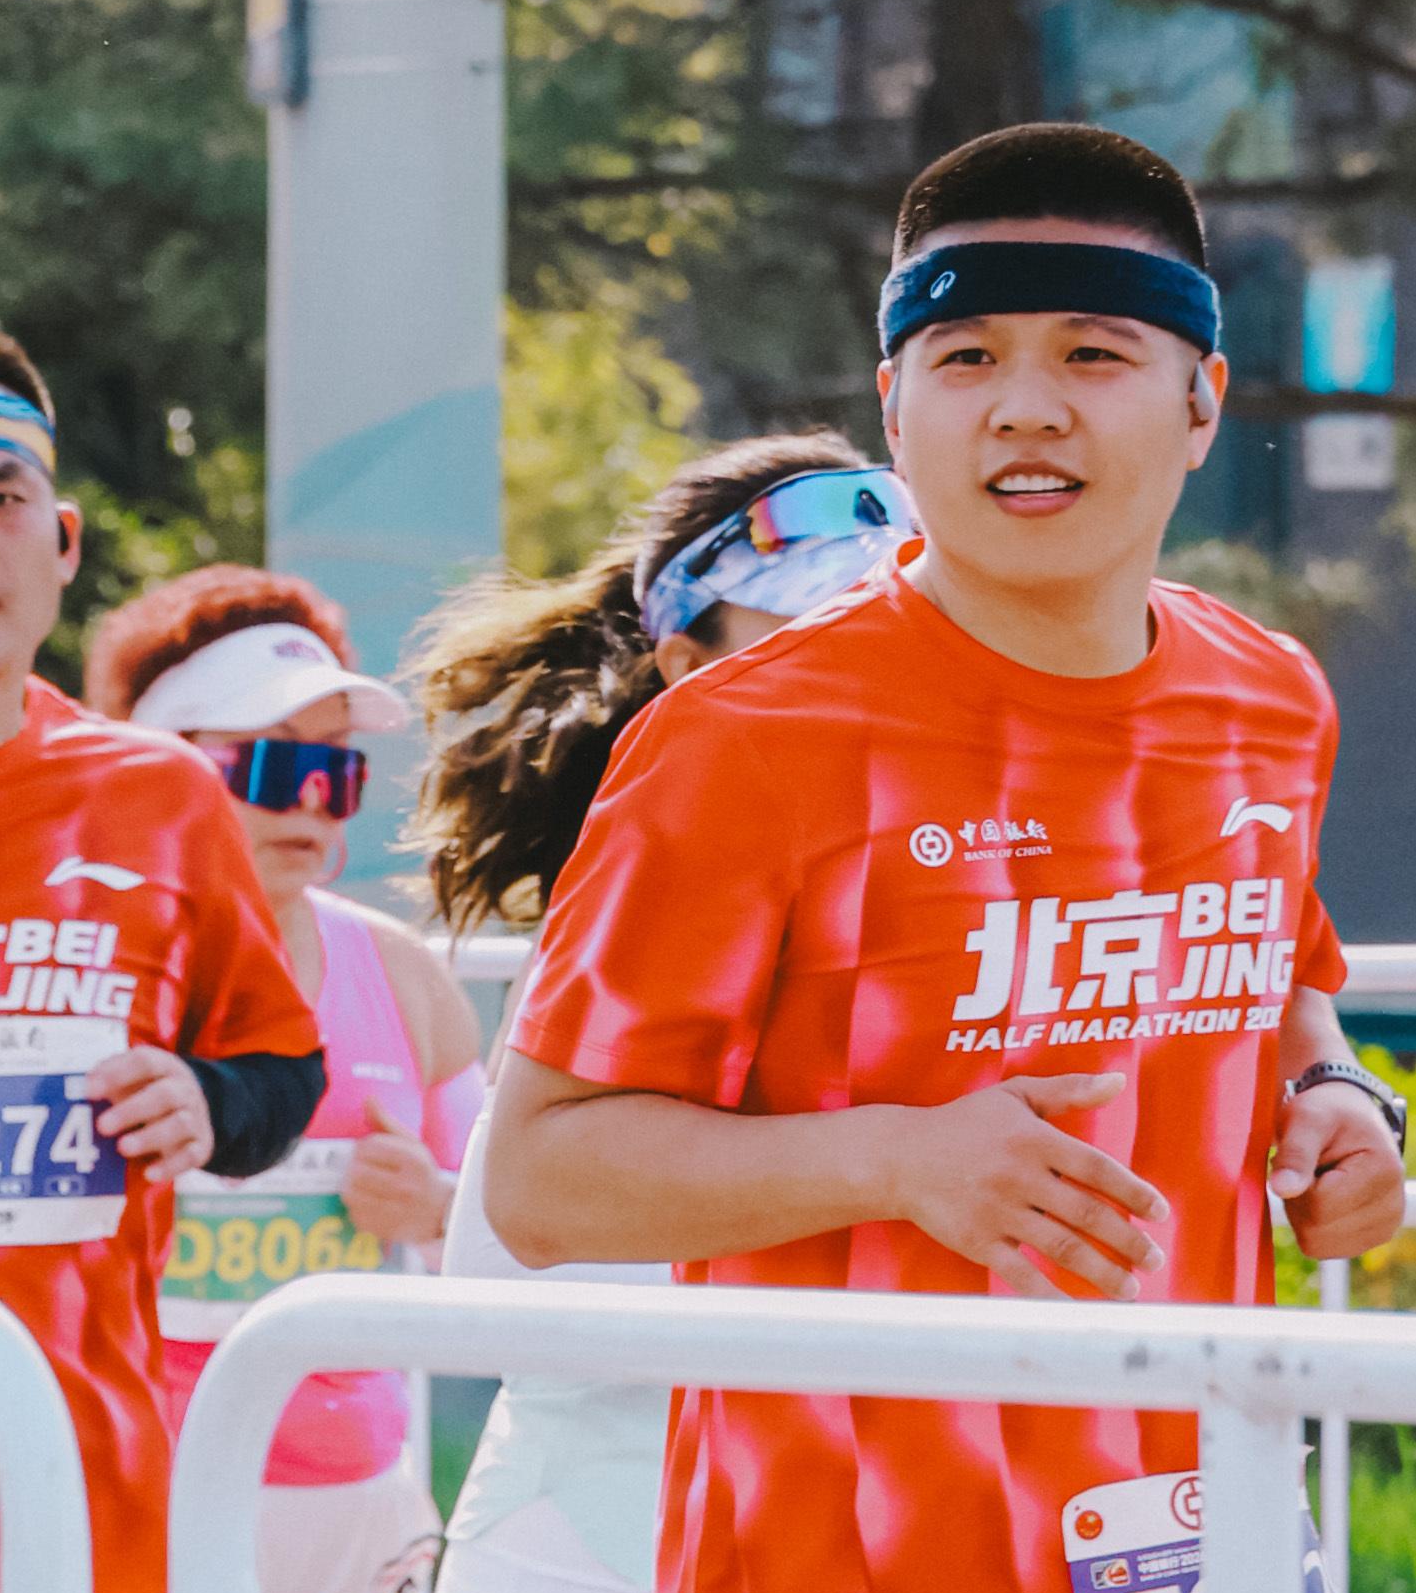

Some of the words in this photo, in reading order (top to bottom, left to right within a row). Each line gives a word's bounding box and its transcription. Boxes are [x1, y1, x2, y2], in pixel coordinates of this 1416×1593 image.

[1178, 878, 1284, 938] BEI
[4, 919, 119, 966] BEI
[952, 889, 1179, 1021] 北京
[1167, 939, 1296, 1002] JING
[945, 1023, 1046, 1052] HALF
[1048, 1007, 1241, 1046] MARATHON
